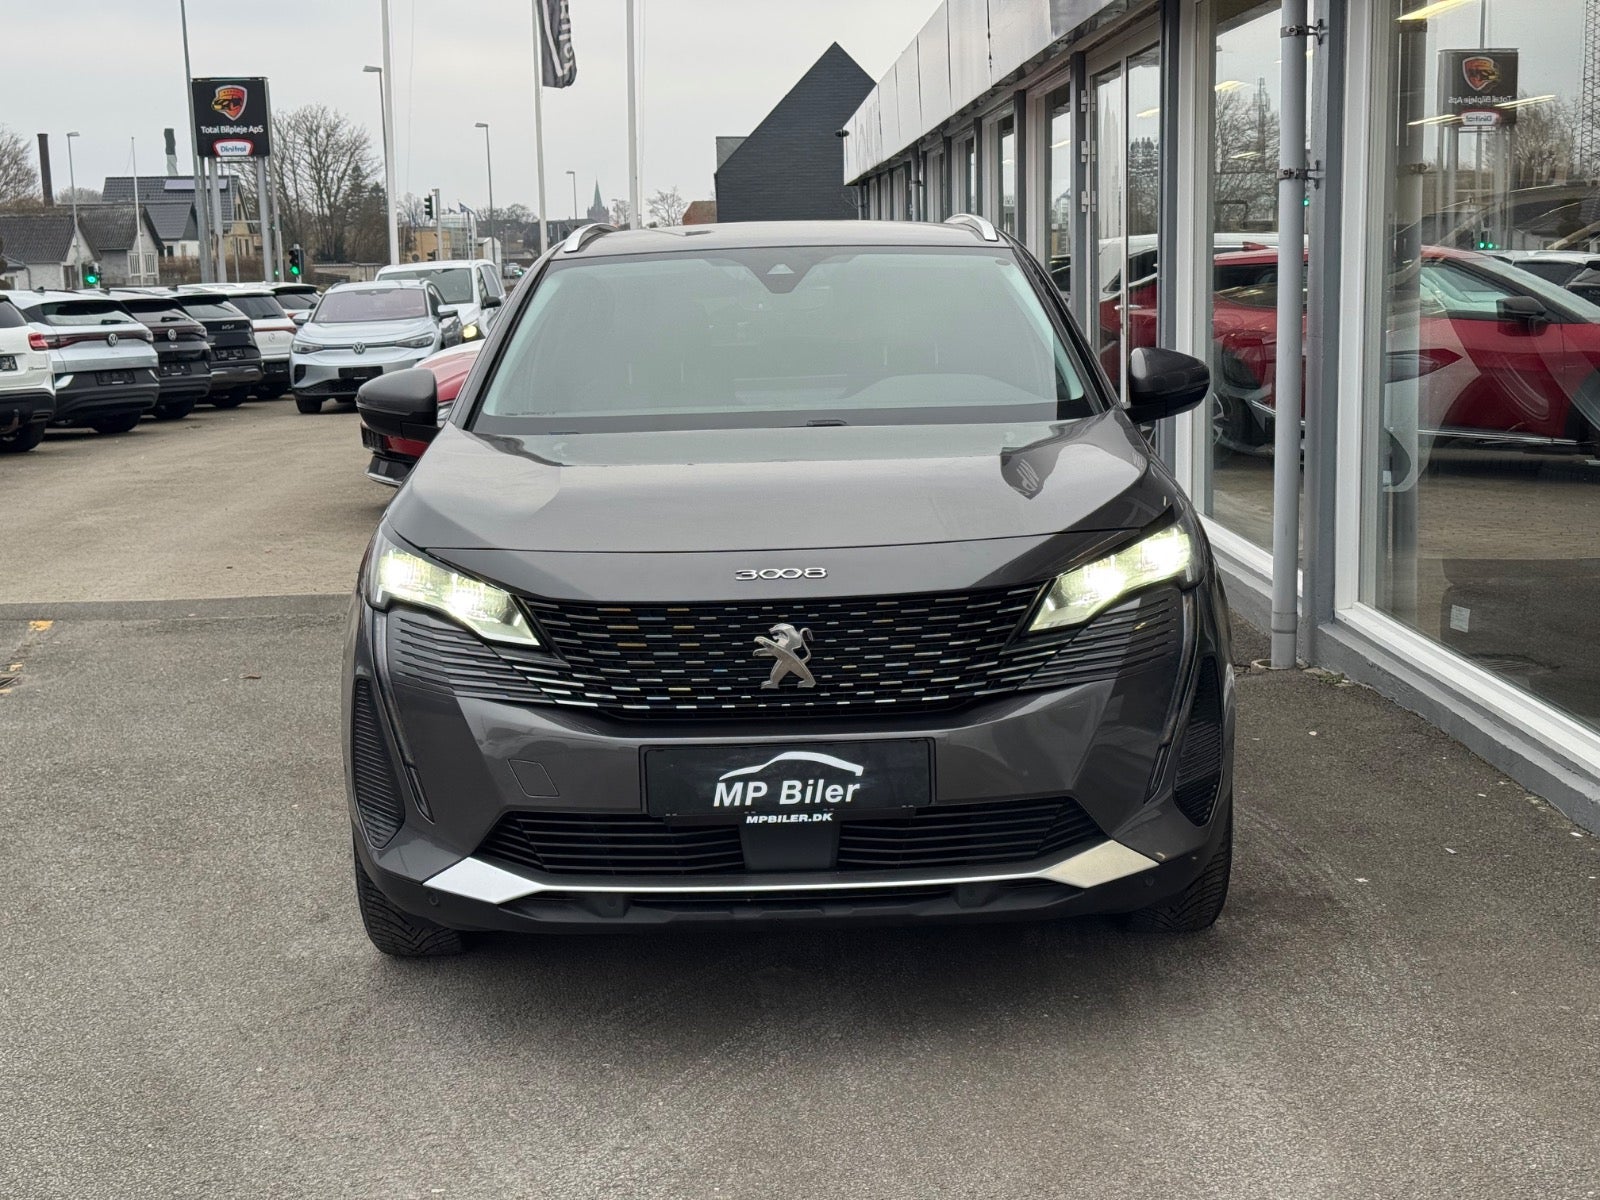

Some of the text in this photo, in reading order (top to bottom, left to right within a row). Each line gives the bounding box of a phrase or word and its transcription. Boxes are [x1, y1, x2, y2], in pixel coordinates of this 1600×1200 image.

[200, 125, 264, 135] Total Bilpleje ApS
[220, 145, 247, 153] Dinitrol
[735, 567, 828, 581] 3008
[713, 778, 860, 808] MP Biler
[746, 812, 833, 824] MPBILER.DK
